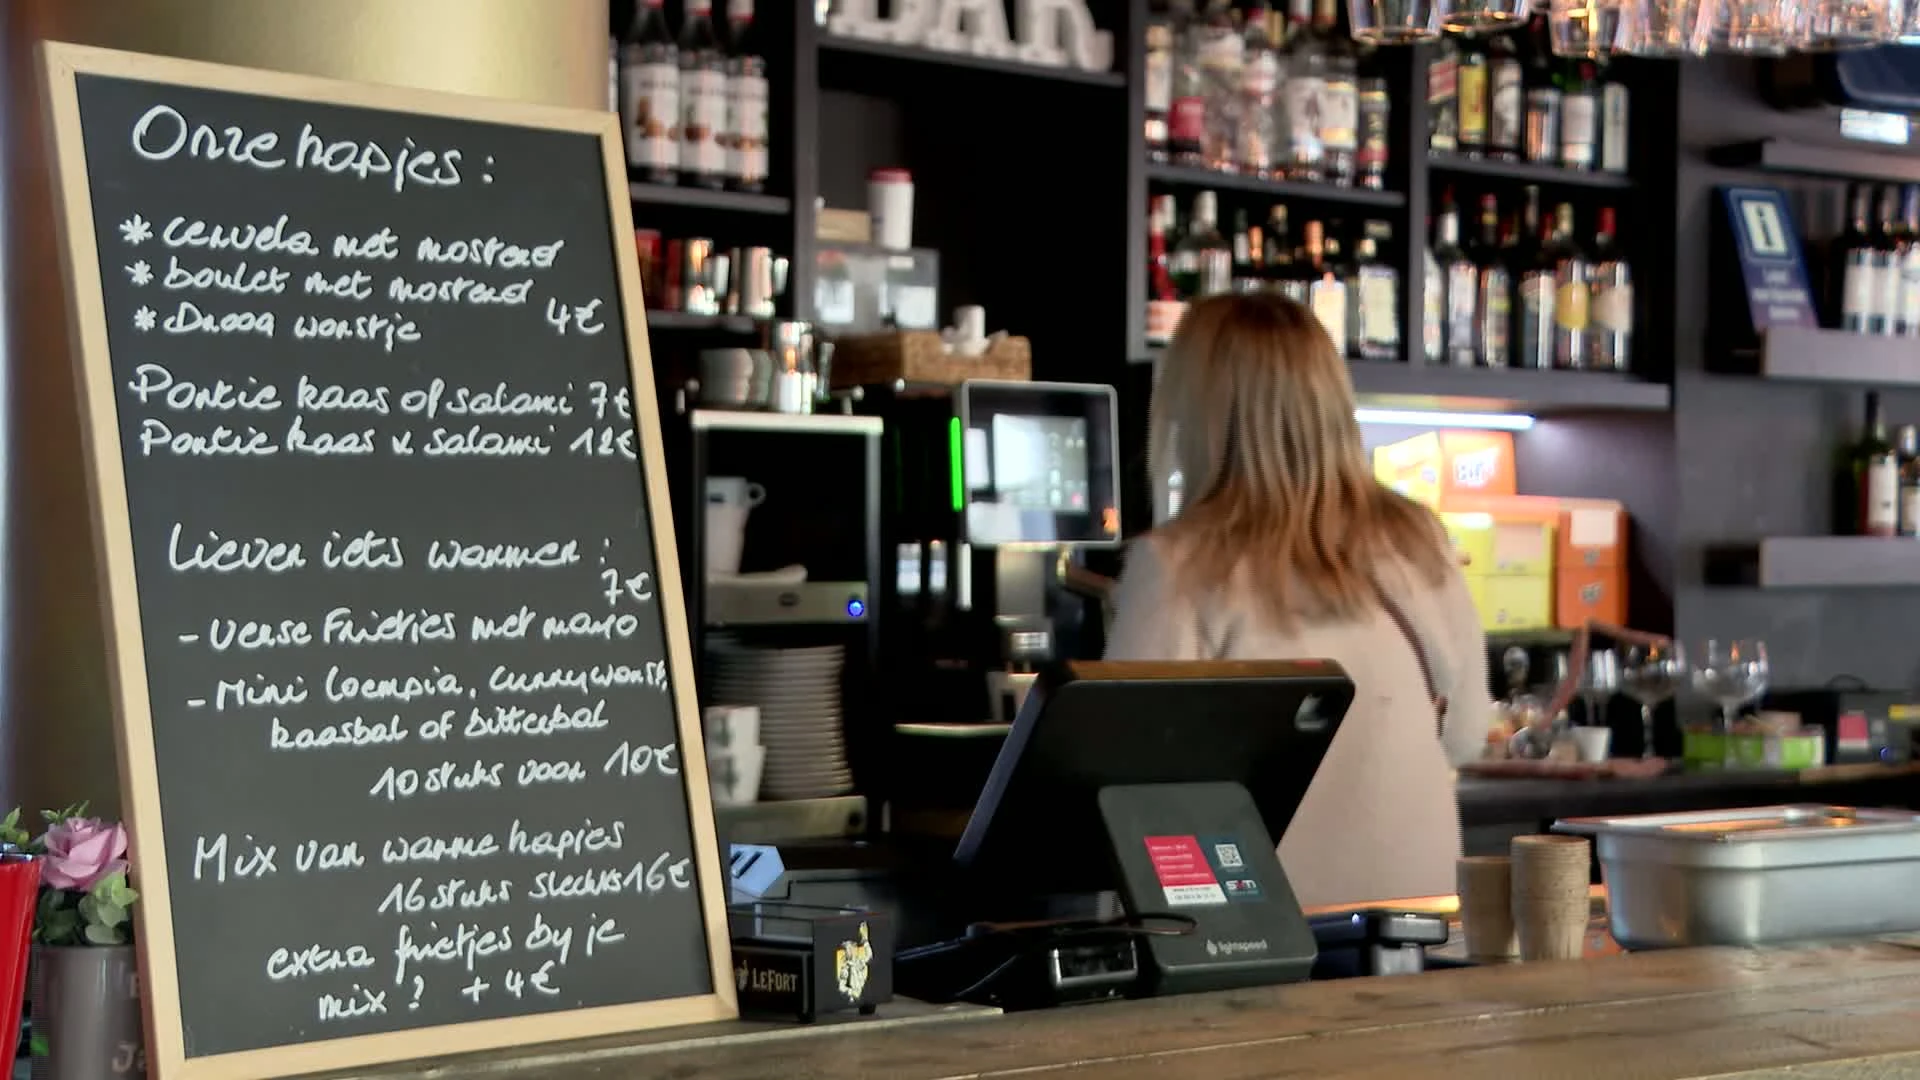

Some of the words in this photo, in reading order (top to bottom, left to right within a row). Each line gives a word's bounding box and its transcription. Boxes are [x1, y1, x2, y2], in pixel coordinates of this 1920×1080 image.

[132, 104, 286, 169] Onze
[295, 123, 462, 193] hapjes
[332, 226, 399, 260] met
[417, 236, 565, 268] mosterd
[163, 255, 291, 294] boulet
[304, 269, 373, 301] met
[388, 276, 535, 305] mosterd
[293, 312, 422, 353] worstje
[546, 297, 605, 335] 4€
[128, 363, 282, 411] Portie
[296, 374, 390, 415] kaas
[400, 377, 445, 419] of
[445, 381, 574, 415] salami
[139, 418, 279, 457] Portie
[286, 414, 376, 456] kaas
[423, 424, 556, 456] salami
[168, 522, 307, 573] Liever
[322, 530, 404, 569] iets
[427, 539, 581, 570] warmer
[600, 567, 652, 606] 7€
[471, 605, 537, 642] met
[542, 612, 638, 641] mayo
[215, 672, 308, 712] Mini
[270, 714, 409, 750] kaasbal
[418, 709, 456, 741] of
[463, 698, 609, 739] bitterbal
[369, 765, 420, 801] 10
[424, 759, 505, 793] stuks
[517, 759, 587, 787] voor
[603, 740, 679, 778] 10€
[193, 832, 279, 884] Mix
[295, 839, 366, 873] van
[381, 832, 500, 865] warme
[377, 876, 426, 914] 16
[429, 878, 513, 911] stuks
[527, 867, 623, 900] slechts
[623, 851, 691, 894] 16€
[266, 943, 376, 982] extra
[524, 912, 573, 966] by
[586, 912, 626, 957] je
[318, 983, 389, 1021] mix
[504, 959, 561, 999] 4€
